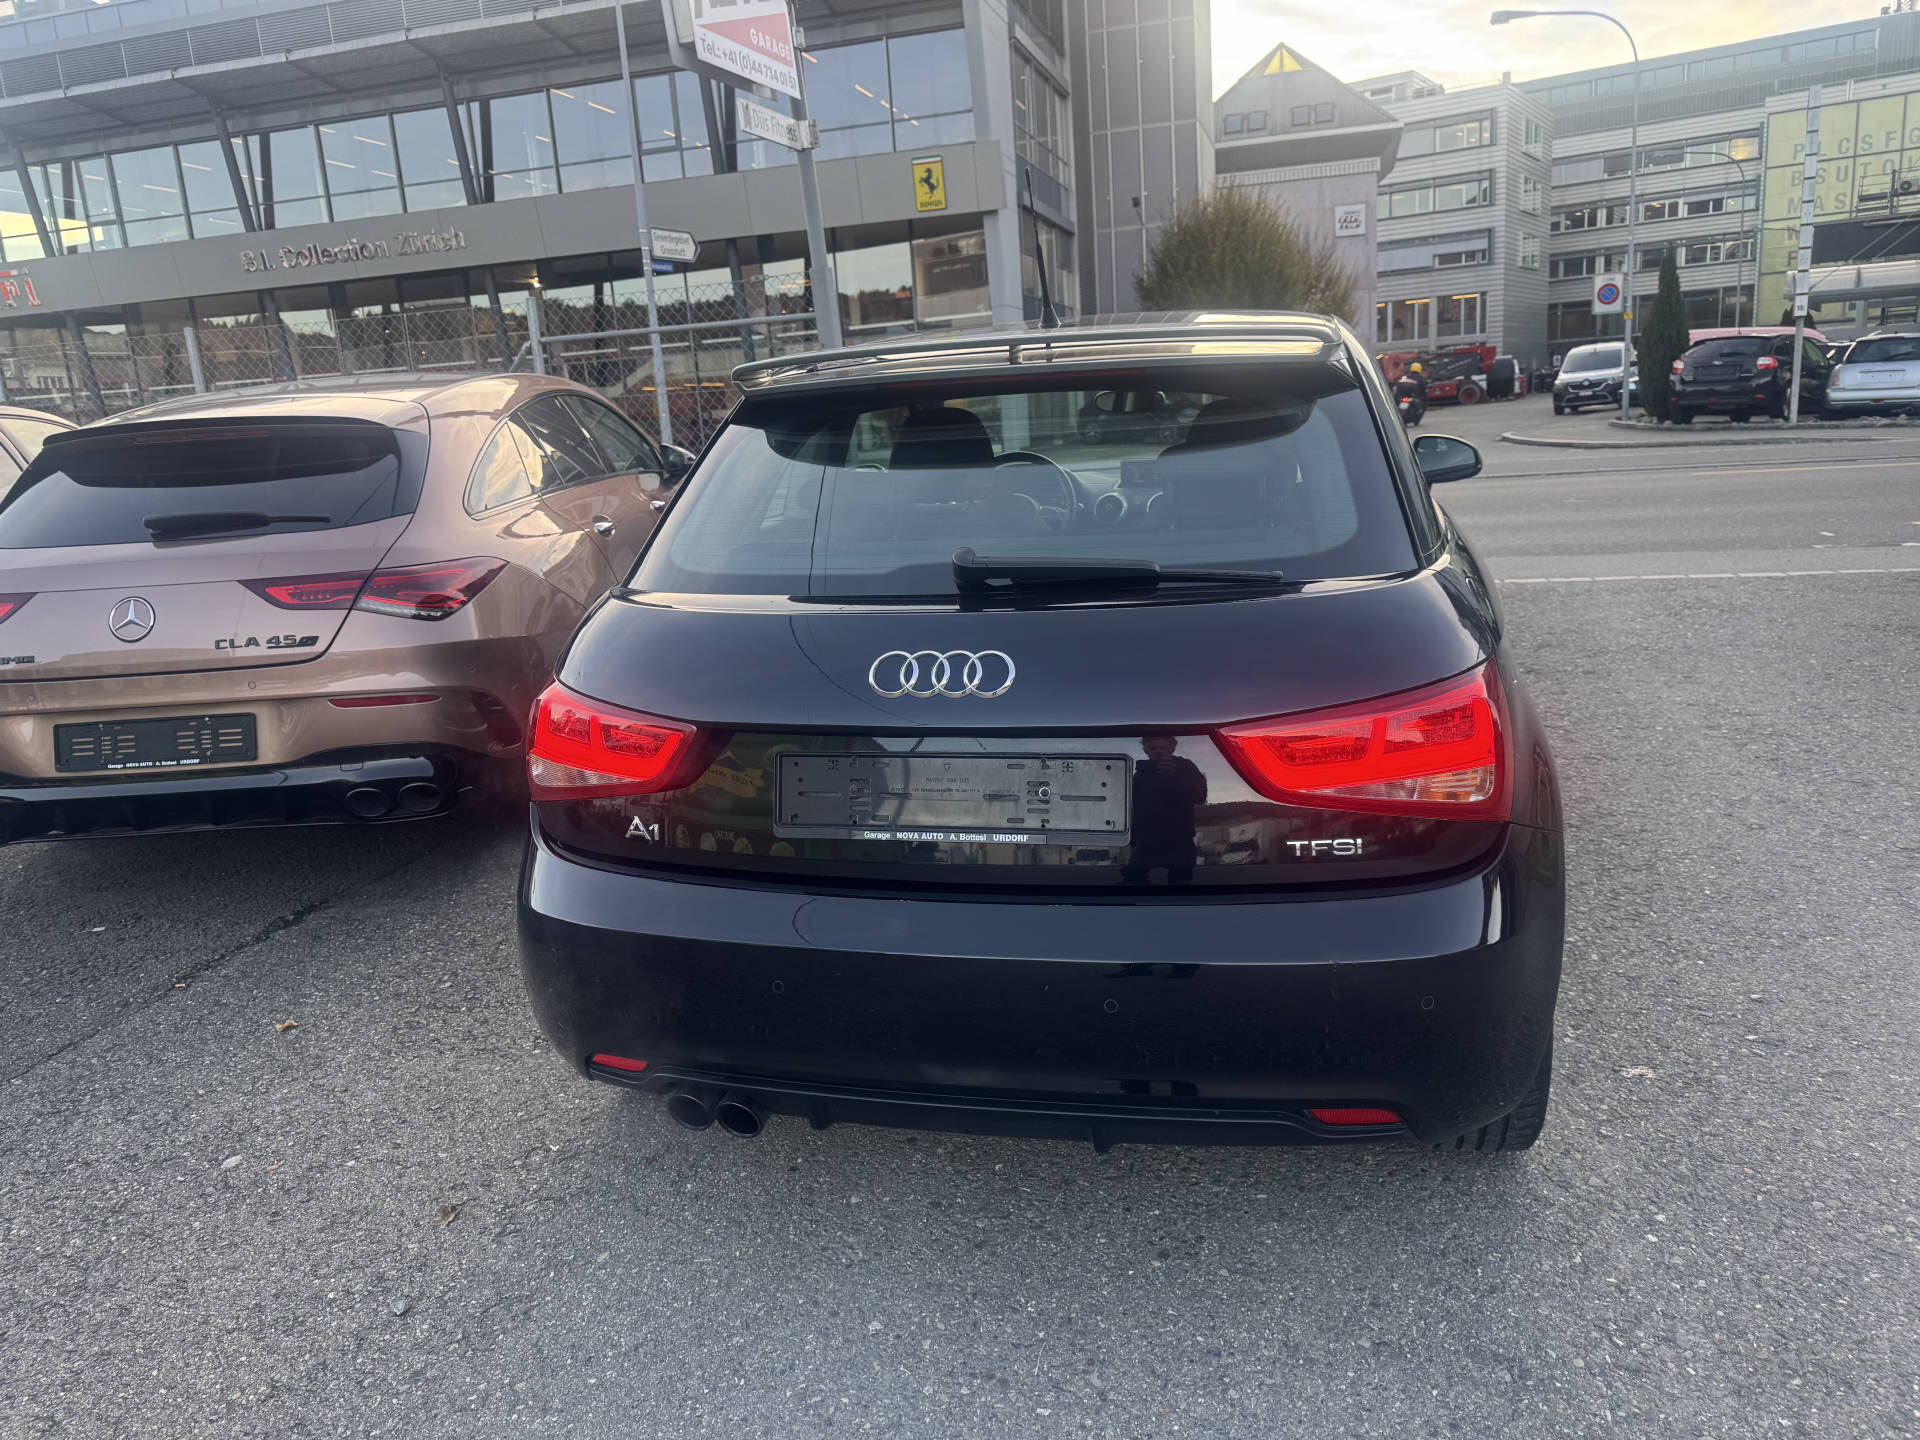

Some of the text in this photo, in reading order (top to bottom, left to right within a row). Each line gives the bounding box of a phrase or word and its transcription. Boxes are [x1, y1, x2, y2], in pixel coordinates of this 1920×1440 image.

[750, 28, 793, 62] GARAGE
[279, 238, 390, 269] Collection
[393, 227, 467, 256] Zürich
[215, 636, 260, 650] CLA
[625, 815, 660, 841] A1
[864, 831, 891, 841] Garage
[896, 832, 919, 840] NOVA
[921, 832, 944, 840] AUTO
[950, 833, 958, 841] A.
[993, 834, 1029, 842] URDORF
[1286, 838, 1363, 857] TFSI
